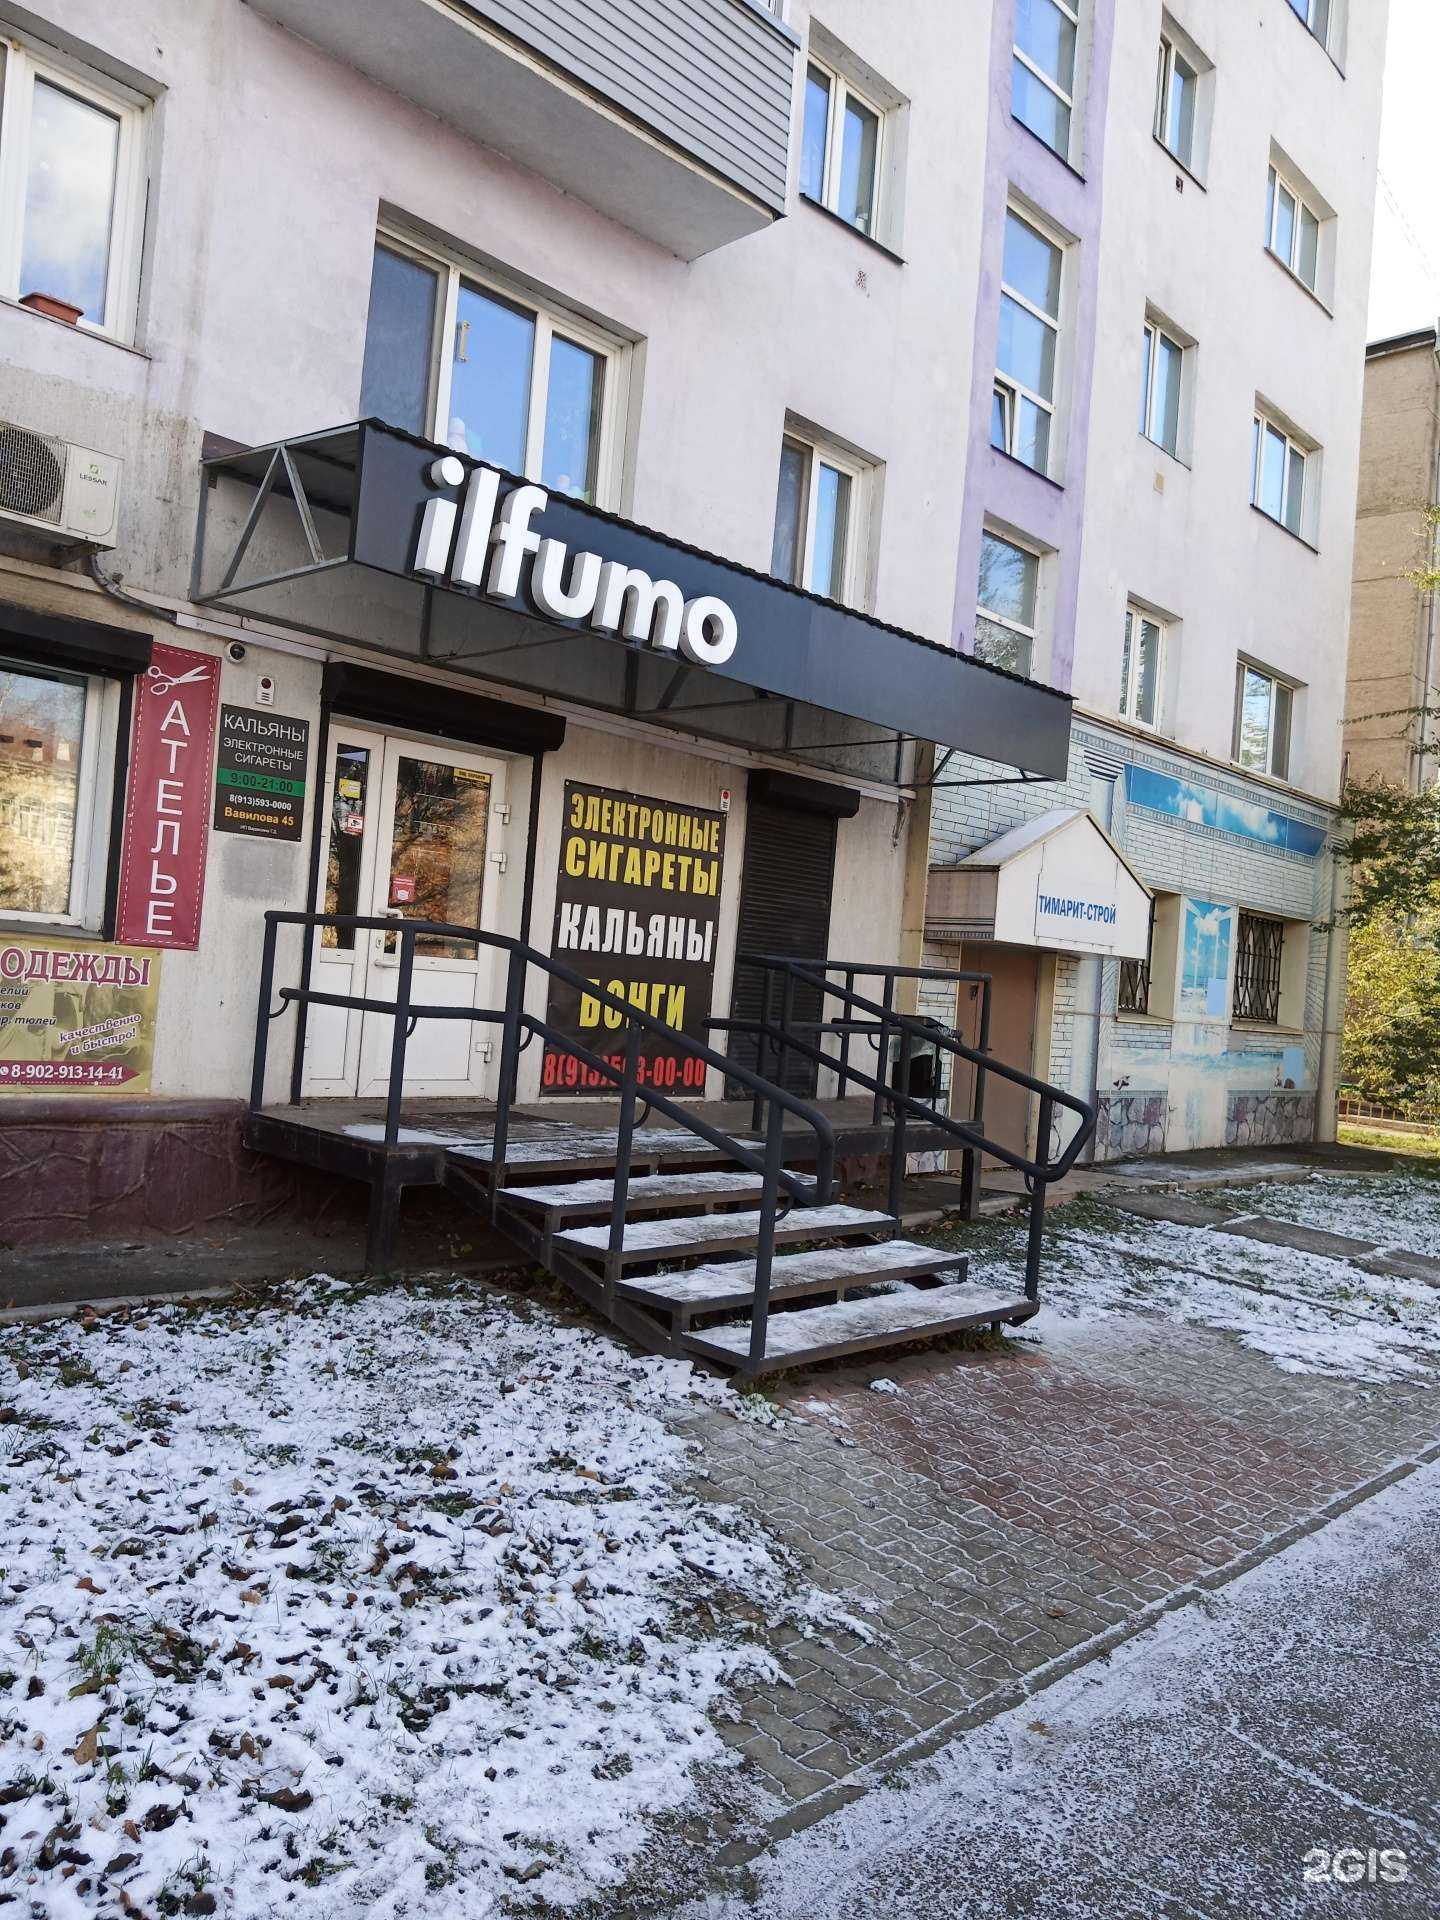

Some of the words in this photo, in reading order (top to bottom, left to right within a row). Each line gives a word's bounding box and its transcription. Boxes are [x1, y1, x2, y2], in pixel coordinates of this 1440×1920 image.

[414, 456, 738, 664] ilfumo
[224, 713, 305, 742] КАЛЬЯНЫ
[223, 737, 304, 760] ЭЛЕКТРОННЫЕ
[235, 752, 292, 771] СИГАРЕТЫ
[230, 772, 293, 793] 9:00-21:00
[224, 806, 279, 824] Вавилова
[281, 814, 295, 826] 45
[229, 794, 292, 810] 8(913)593-0000
[146, 700, 190, 936] АТЕЛЬЕ
[570, 792, 720, 853] ЭЛЕКТРОННЫЕ
[565, 836, 719, 896] СИГАРЕТЫ
[1039, 895, 1116, 924] ТИМАРИТ-СТРОЙ
[557, 902, 714, 963] КАЛЬЯНЫ
[0, 947, 151, 987] ОДЕЖДЫ
[14, 1015, 57, 1026] тюлей
[59, 1013, 141, 1043] качественно
[69, 1046, 80, 1055] и
[83, 1027, 136, 1052] быстро!
[11, 1064, 123, 1079] 8-902-913-14-41
